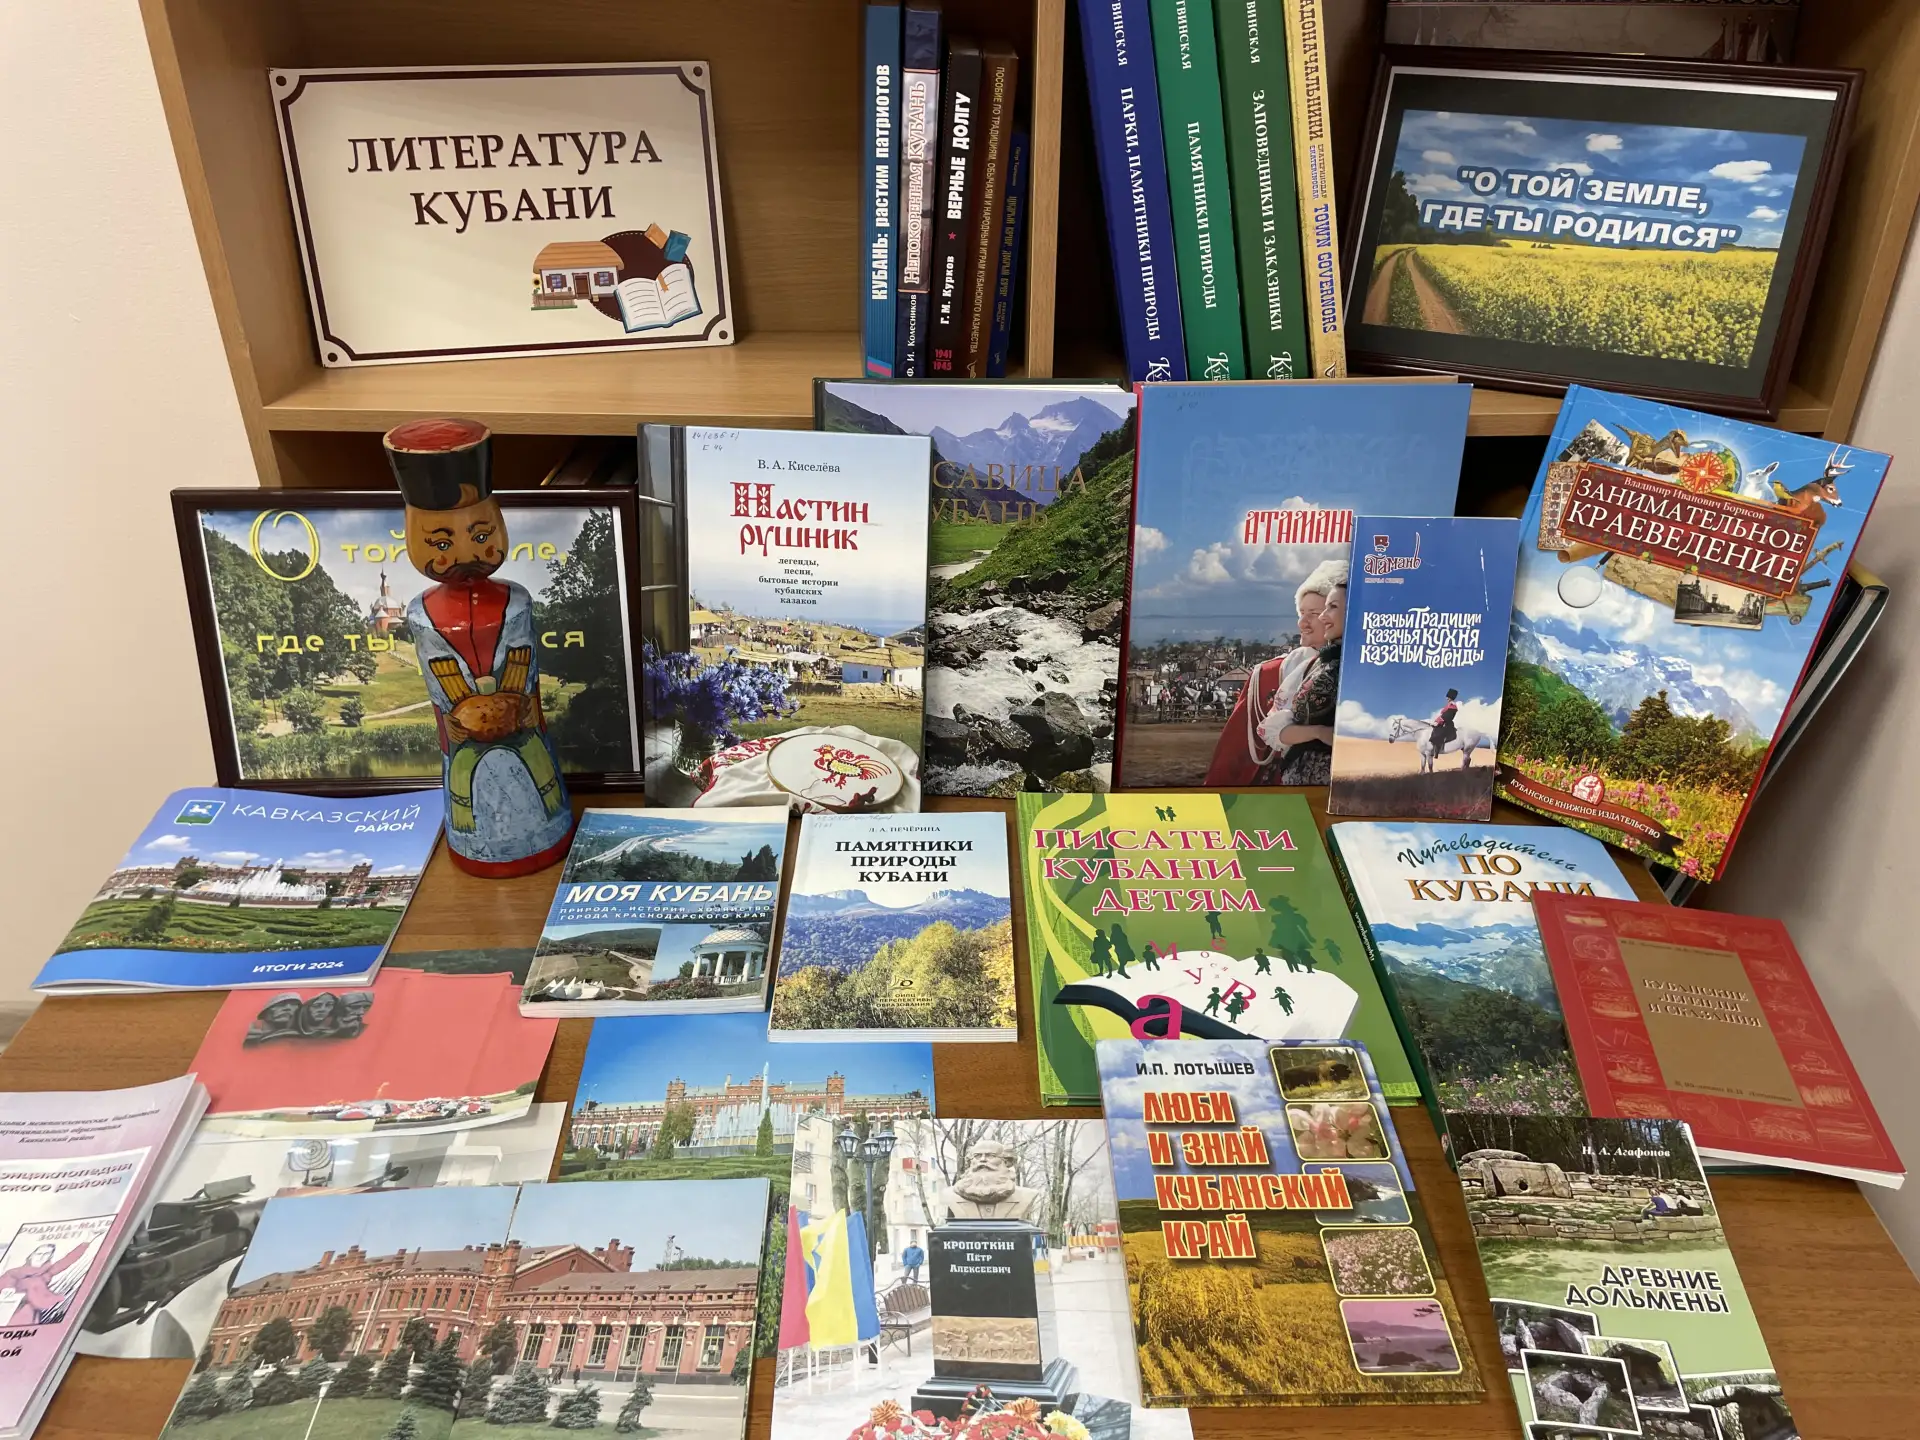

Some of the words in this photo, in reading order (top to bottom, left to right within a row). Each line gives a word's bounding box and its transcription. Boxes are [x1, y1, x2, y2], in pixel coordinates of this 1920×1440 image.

[1111, 0, 1128, 66] ВИНСКАЯ
[992, 66, 1005, 103] ПОСОБИЕ
[876, 64, 891, 158] патриотов
[952, 91, 972, 149] ДОЛГУ
[992, 104, 1002, 116] ПО
[1120, 87, 1139, 153] ПАРКИ,
[347, 130, 662, 175] ЛИТЕРАТУРА
[1252, 89, 1275, 216] ЗАПОВЕДНИКИ
[875, 163, 889, 228] растим
[948, 156, 967, 221] ВЕРНЫЕ
[984, 162, 997, 199] ОБЫЧАЯМ
[1461, 170, 1499, 194] "О
[1507, 172, 1576, 199] ТОЙ
[1583, 179, 1709, 215] ЗЕМЛЕ,
[410, 186, 616, 233] КУБАНИ
[1128, 154, 1152, 261] ПАМЯТНИКИ
[1187, 121, 1209, 229] ПАМЯТНИКИ
[1198, 232, 1217, 309] ПРИРОДЫ
[978, 206, 992, 246] НАРОДНЫМ
[1262, 220, 1275, 232] И
[1313, 203, 1331, 247] TOWN
[1421, 203, 1494, 230] ГДЕ
[1496, 209, 1546, 233] ТЫ
[1553, 215, 1738, 250] РОДИЛСЯ"
[872, 229, 889, 301] КУБАНЬ:
[977, 247, 988, 269] ИГРАМ
[942, 255, 955, 297] Курков
[973, 270, 986, 313] КУБАНСКОГО
[1263, 235, 1283, 331] ЗАКАЗНИКИ
[1140, 264, 1160, 340] ПРИРОДЫ
[1317, 252, 1337, 334] GOVERNORS
[906, 294, 917, 347] Колесников
[969, 313, 982, 354] КАЗАЧЕСТВА
[932, 360, 952, 371] 1945
[934, 348, 952, 359] 1941
[905, 363, 915, 378] Ф.
[757, 459, 770, 470] В.
[772, 460, 785, 470] А.
[788, 460, 841, 474] Киселёва
[933, 460, 1088, 494] САВИЦА
[932, 498, 1048, 528] УБАНЬ
[1623, 477, 1673, 498] Владимир
[1672, 488, 1722, 511] Иванович
[1722, 502, 1765, 521] Борисов
[1576, 478, 1807, 554] ЗАНИМАТЕЛЬНОЕ
[248, 508, 320, 582] О
[1566, 501, 1800, 583] КРАЕВЕДЕНИЕ
[778, 558, 819, 567] легенды,
[784, 568, 814, 577] песни,
[758, 576, 799, 585] бытовые
[801, 579, 839, 588] истории
[774, 586, 823, 596] кубанских
[780, 597, 817, 605] казаков
[256, 633, 324, 656] где
[231, 803, 421, 825] КАВКАЗСКИЙ
[1510, 778, 1554, 806] КУБАНСКОЕ
[1554, 799, 1597, 817] КНИЖНОЕ
[1597, 810, 1661, 839] ИЗДАТЕЛЬСТВО
[354, 821, 415, 834] РАЙОН
[1033, 828, 1298, 851] ПИСАТЕЛИ
[835, 840, 974, 852] ПАМЯТНИКИ
[850, 855, 957, 869] ПРИРОДЫ
[1397, 833, 1579, 872] Путеводитель
[858, 870, 949, 883] КУБАНИ
[1042, 857, 1246, 884] КУБАНИ
[1456, 853, 1522, 876] ПО
[565, 884, 643, 904] МОЯ
[648, 884, 774, 904] КУБАНЬ
[1093, 888, 1265, 916] ДЕТЯМ
[560, 912, 609, 921] ГОРОДА
[615, 911, 729, 921] КРАСНОДАРСКОГО
[735, 911, 767, 920] КРАЯ
[252, 962, 307, 975] ИТОГИ
[307, 960, 346, 972] 2024
[1642, 978, 1750, 1002] КУБАНСКИЕ
[1660, 992, 1742, 1013] ЛЕГЕНДЫ
[1649, 1003, 1662, 1014] И
[1665, 1004, 1763, 1027] СКАЗАНИЯ
[1135, 1062, 1169, 1076] И.П.
[1173, 1062, 1255, 1076] ЛОТЫШЕВ
[1143, 1091, 1236, 1124] ЛЮБИ
[1147, 1131, 1174, 1166] И
[1181, 1125, 1269, 1165] ЗНАЙ
[1582, 1145, 1595, 1156] Н.
[1598, 1146, 1611, 1157] А.
[1614, 1146, 1671, 1159] Агафонов
[55, 1176, 122, 1193] района
[1154, 1167, 1353, 1211] КУБАНСКИЙ
[943, 1241, 1015, 1250] КРОПОТКИН
[1161, 1213, 1257, 1259] КРАЙ
[1600, 1265, 1723, 1292] ДРЕВНИЕ
[1565, 1283, 1730, 1314] ДОЛЬМЕНЫ
